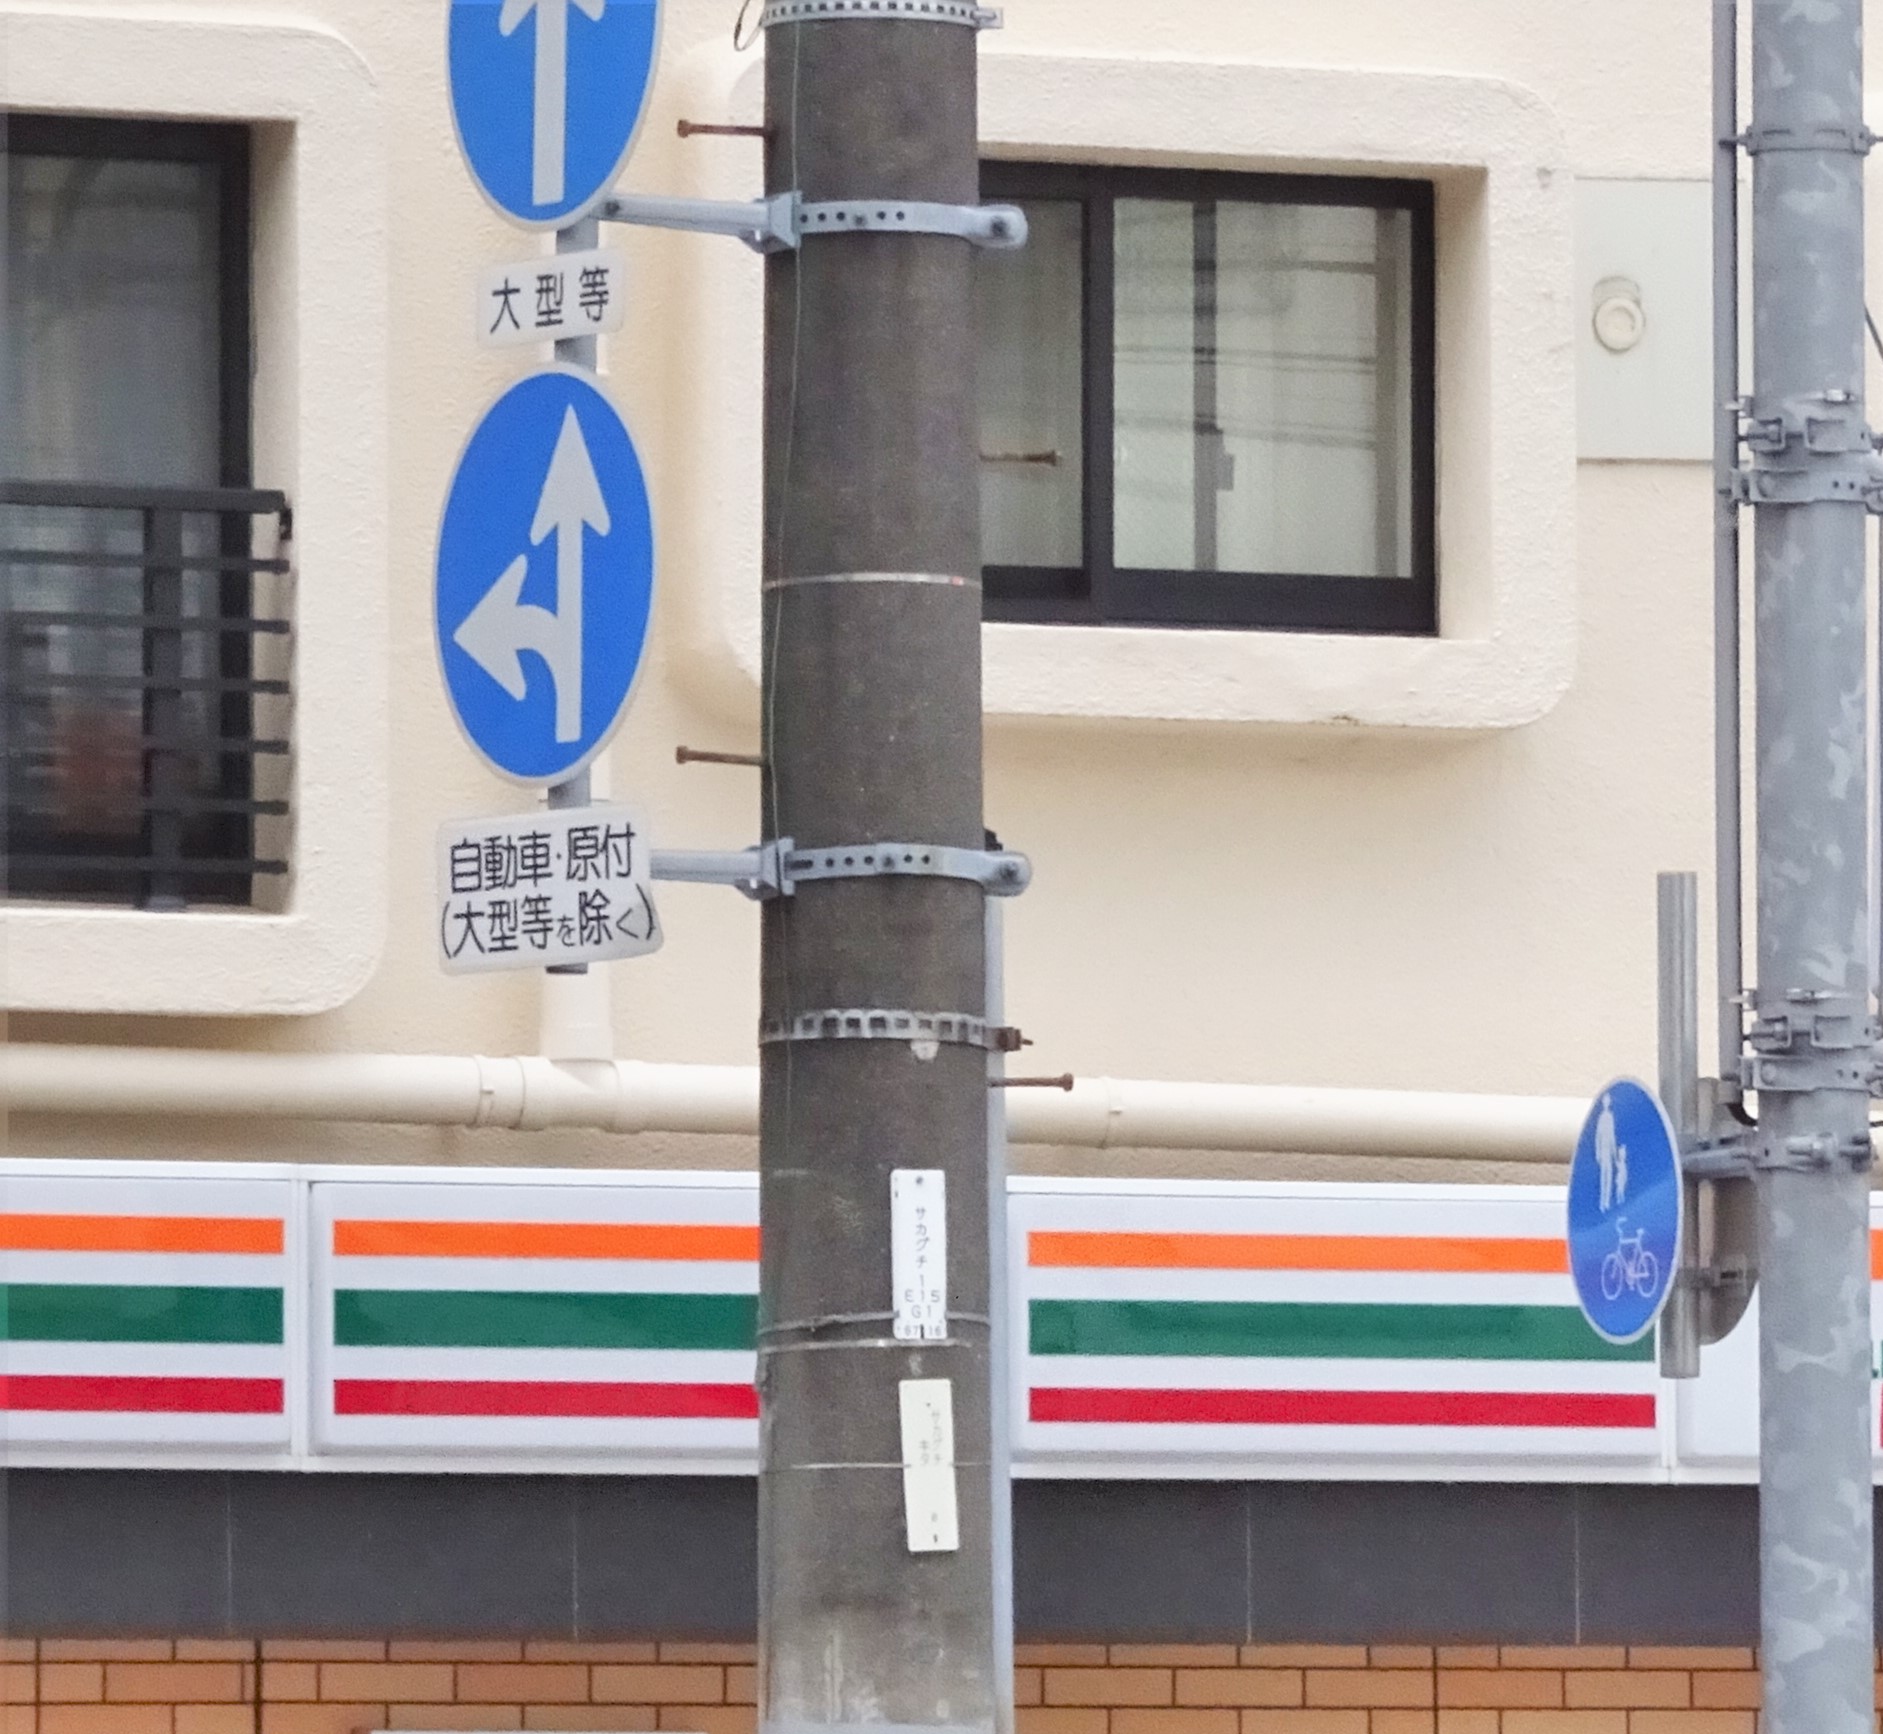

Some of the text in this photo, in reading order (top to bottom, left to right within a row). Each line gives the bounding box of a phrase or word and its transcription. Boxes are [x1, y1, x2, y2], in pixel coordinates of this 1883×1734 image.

[490, 265, 611, 335] 大型等
[449, 822, 637, 895] 自動車・原付
